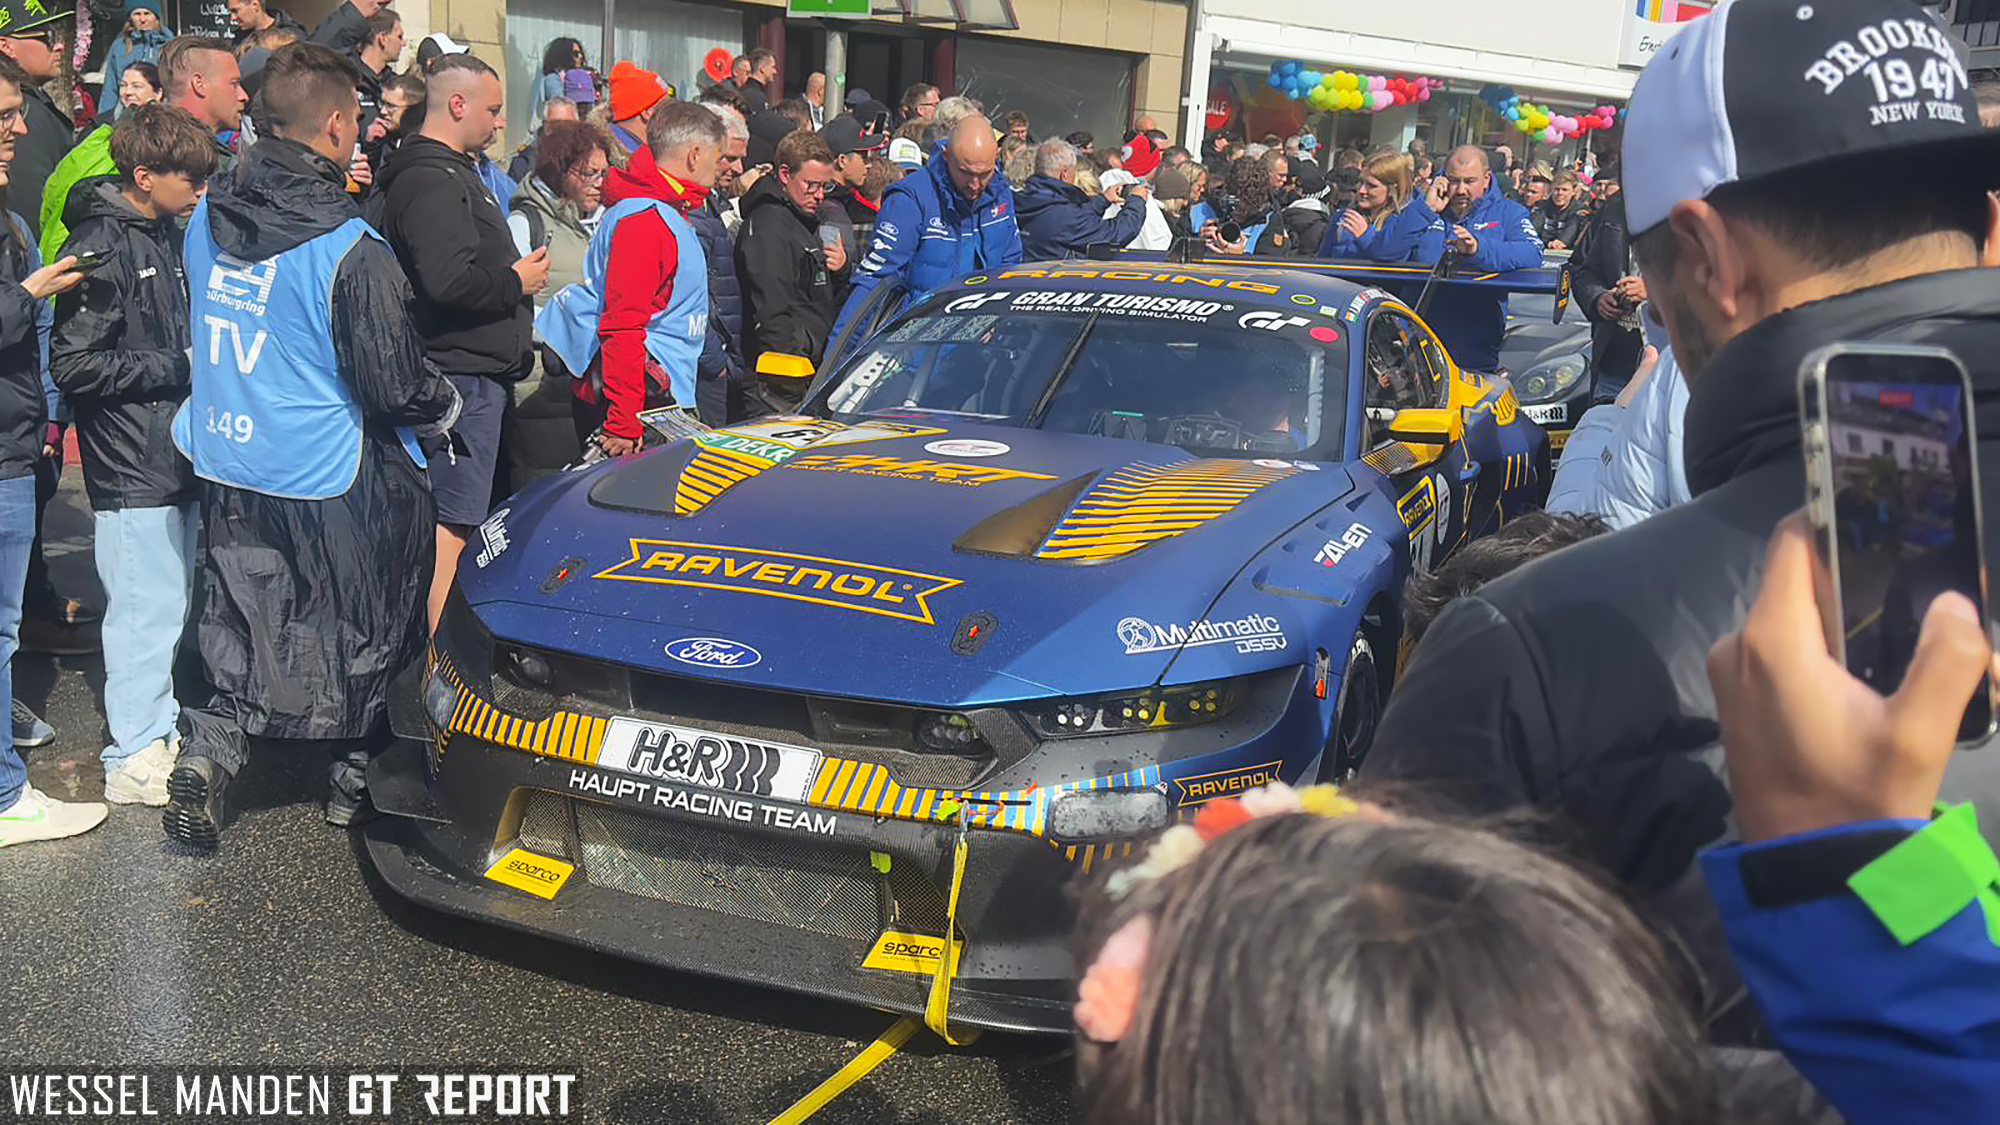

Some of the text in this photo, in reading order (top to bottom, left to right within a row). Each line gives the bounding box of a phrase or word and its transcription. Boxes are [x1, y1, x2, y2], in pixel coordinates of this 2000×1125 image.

[1805, 18, 1968, 94] BROOKL
[1863, 58, 1954, 103] 1947
[1869, 102, 1966, 126] NEW YORK
[999, 270, 1281, 295] RACING
[1012, 291, 1086, 306] GRAN
[1071, 307, 1126, 316] DRIVING
[1128, 311, 1208, 323] SIMULATOR
[204, 314, 268, 375] TV
[206, 405, 254, 444] 149
[850, 469, 924, 481] RACING
[929, 476, 981, 488] TEAM
[1154, 613, 1281, 646] Multimatic
[678, 639, 746, 666] Ford
[1235, 636, 1288, 654] DSSV
[628, 727, 728, 787] H&R
[1188, 771, 1273, 797] RAVENOL
[568, 769, 837, 835] HAUPT RACING TEAM
[508, 859, 561, 882] sparco
[884, 941, 943, 956] sparc
